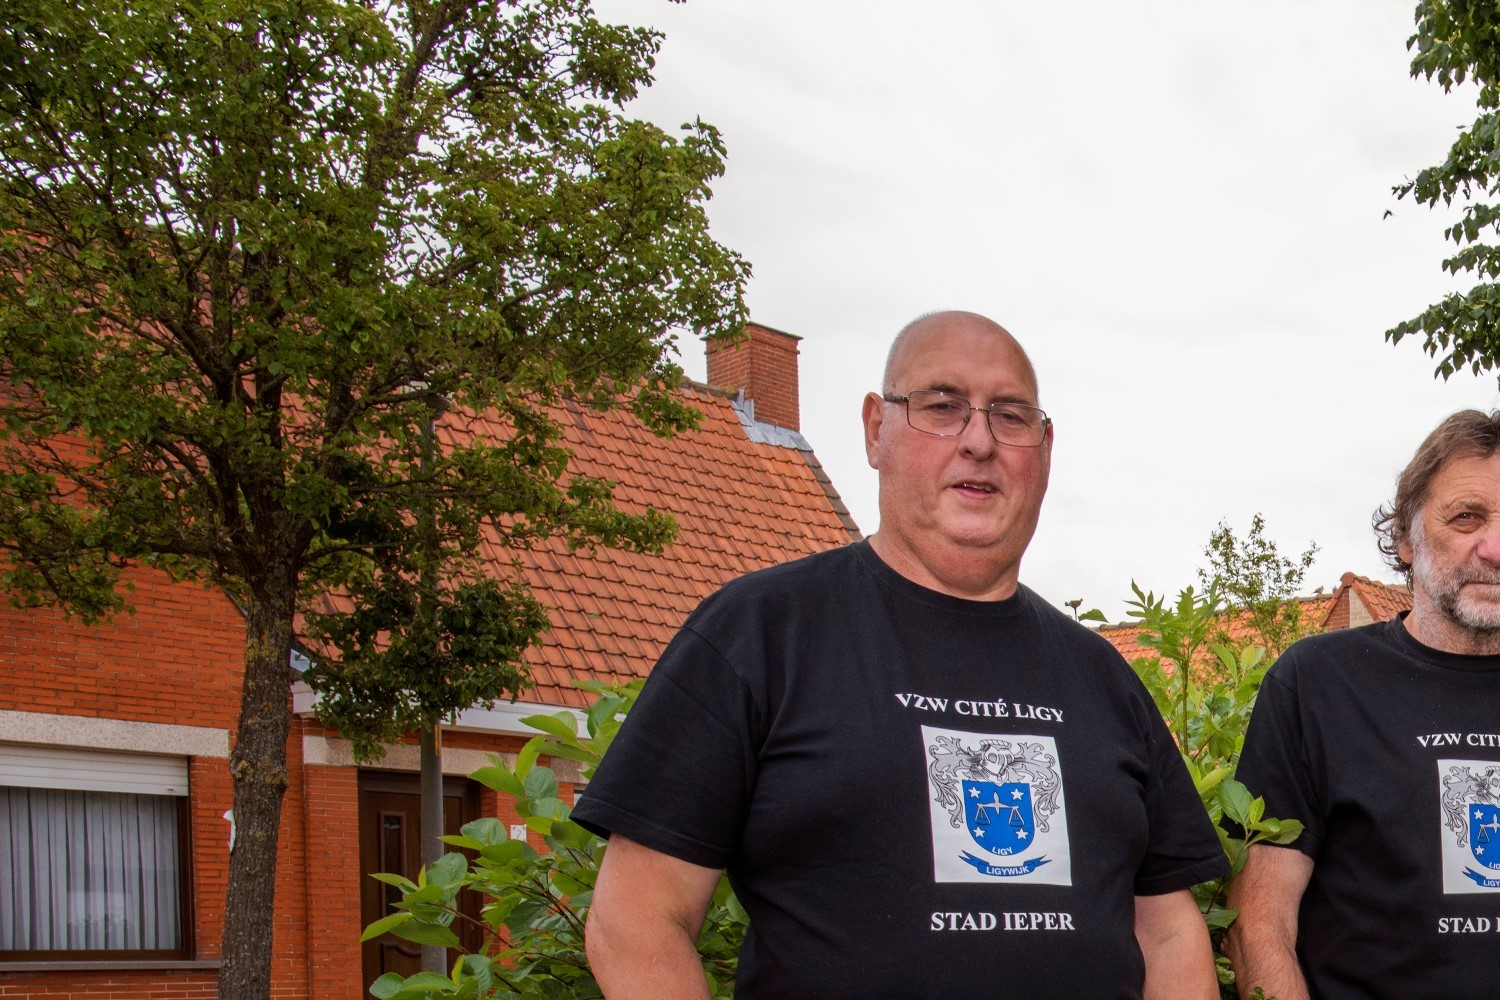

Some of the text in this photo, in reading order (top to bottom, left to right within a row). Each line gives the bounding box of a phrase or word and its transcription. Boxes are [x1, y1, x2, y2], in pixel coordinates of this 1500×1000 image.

[895, 693, 1065, 722] VZW CITÉ LIGY
[1416, 733, 1463, 748] VZW
[991, 845, 1014, 856] LIGY
[985, 865, 1030, 875] LIGYWIJK
[931, 912, 1076, 931] STAD IEPER
[1438, 916, 1491, 933] STAD
